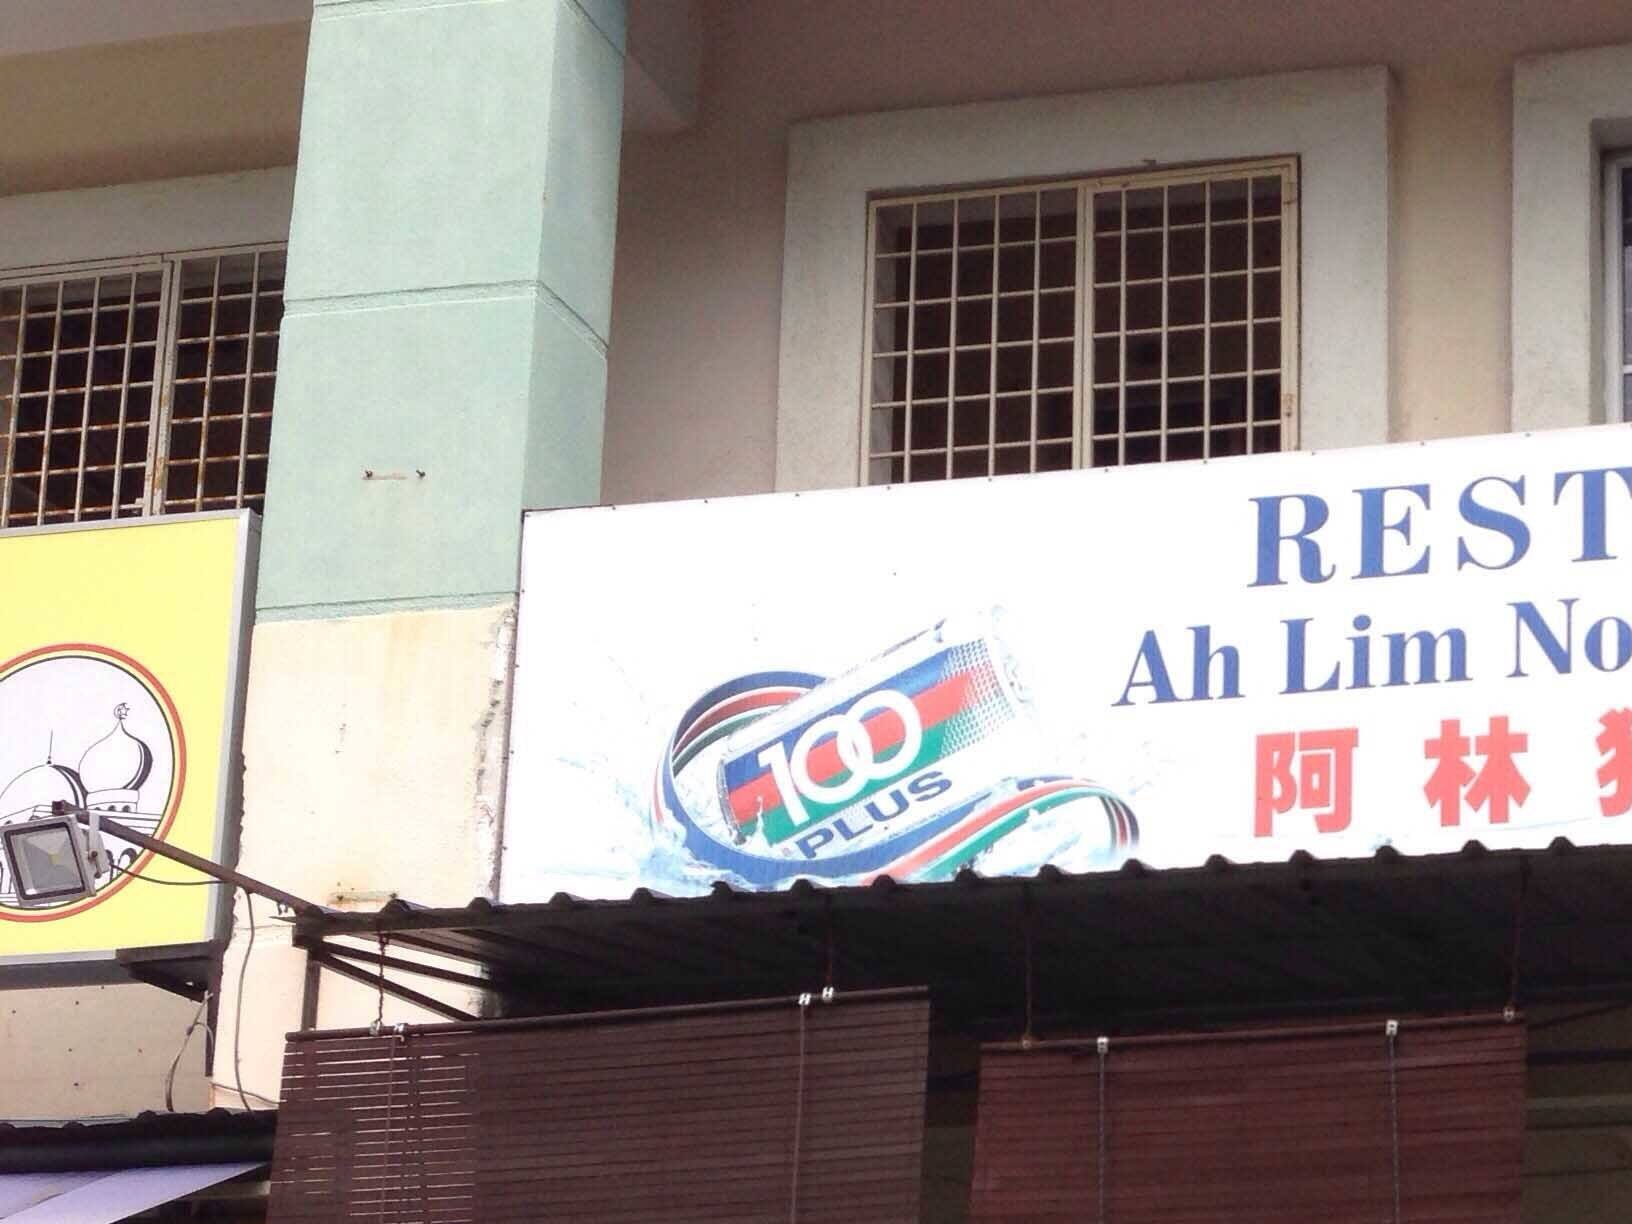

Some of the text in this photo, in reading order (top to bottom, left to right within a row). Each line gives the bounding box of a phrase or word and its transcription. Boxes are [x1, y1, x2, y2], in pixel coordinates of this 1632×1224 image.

[1111, 625, 1245, 707] Ah
[1278, 614, 1474, 696] Lim
[757, 688, 924, 829] 100
[795, 770, 952, 859] PLUS
